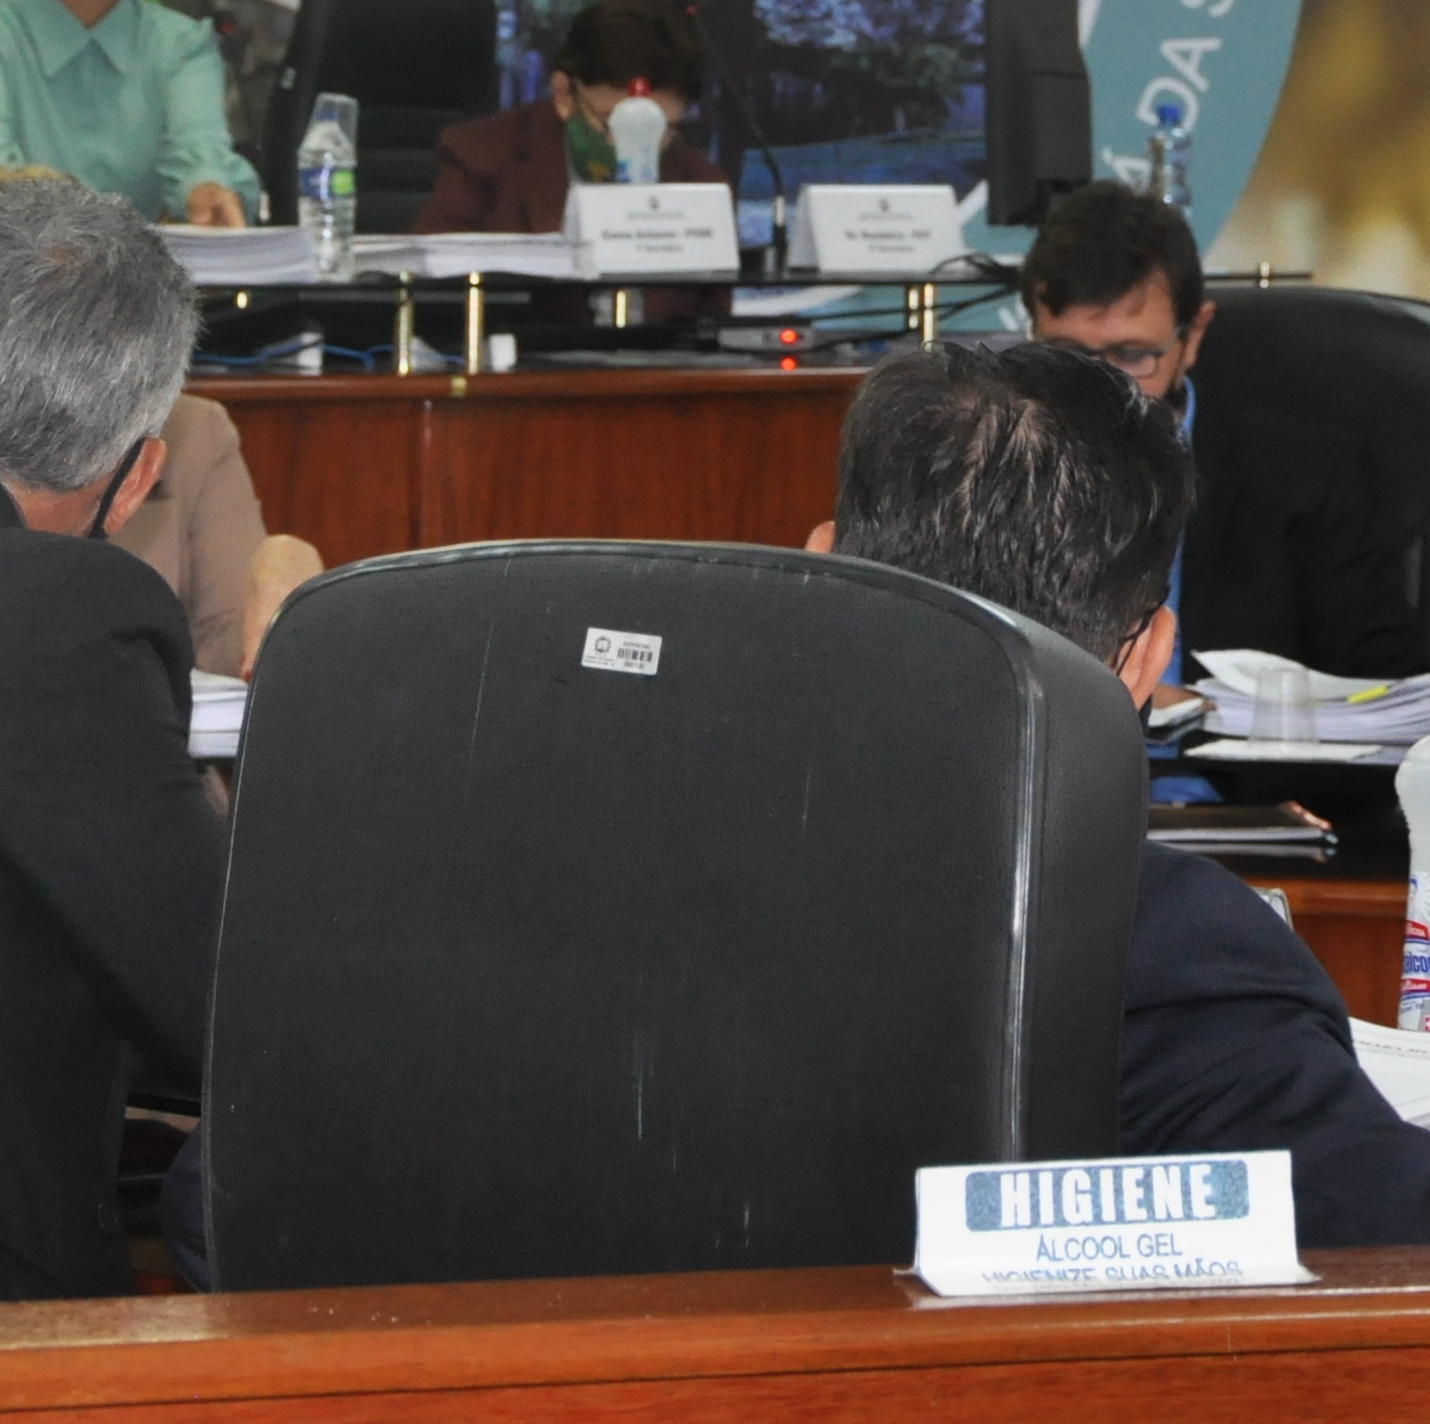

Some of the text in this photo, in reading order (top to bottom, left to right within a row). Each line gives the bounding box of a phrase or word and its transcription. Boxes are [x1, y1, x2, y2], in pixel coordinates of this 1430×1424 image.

[1136, 35, 1226, 133] DA
[999, 1163, 1217, 1228] HIGIENE
[1035, 1232, 1183, 1262] ÁLCOOL GEL
